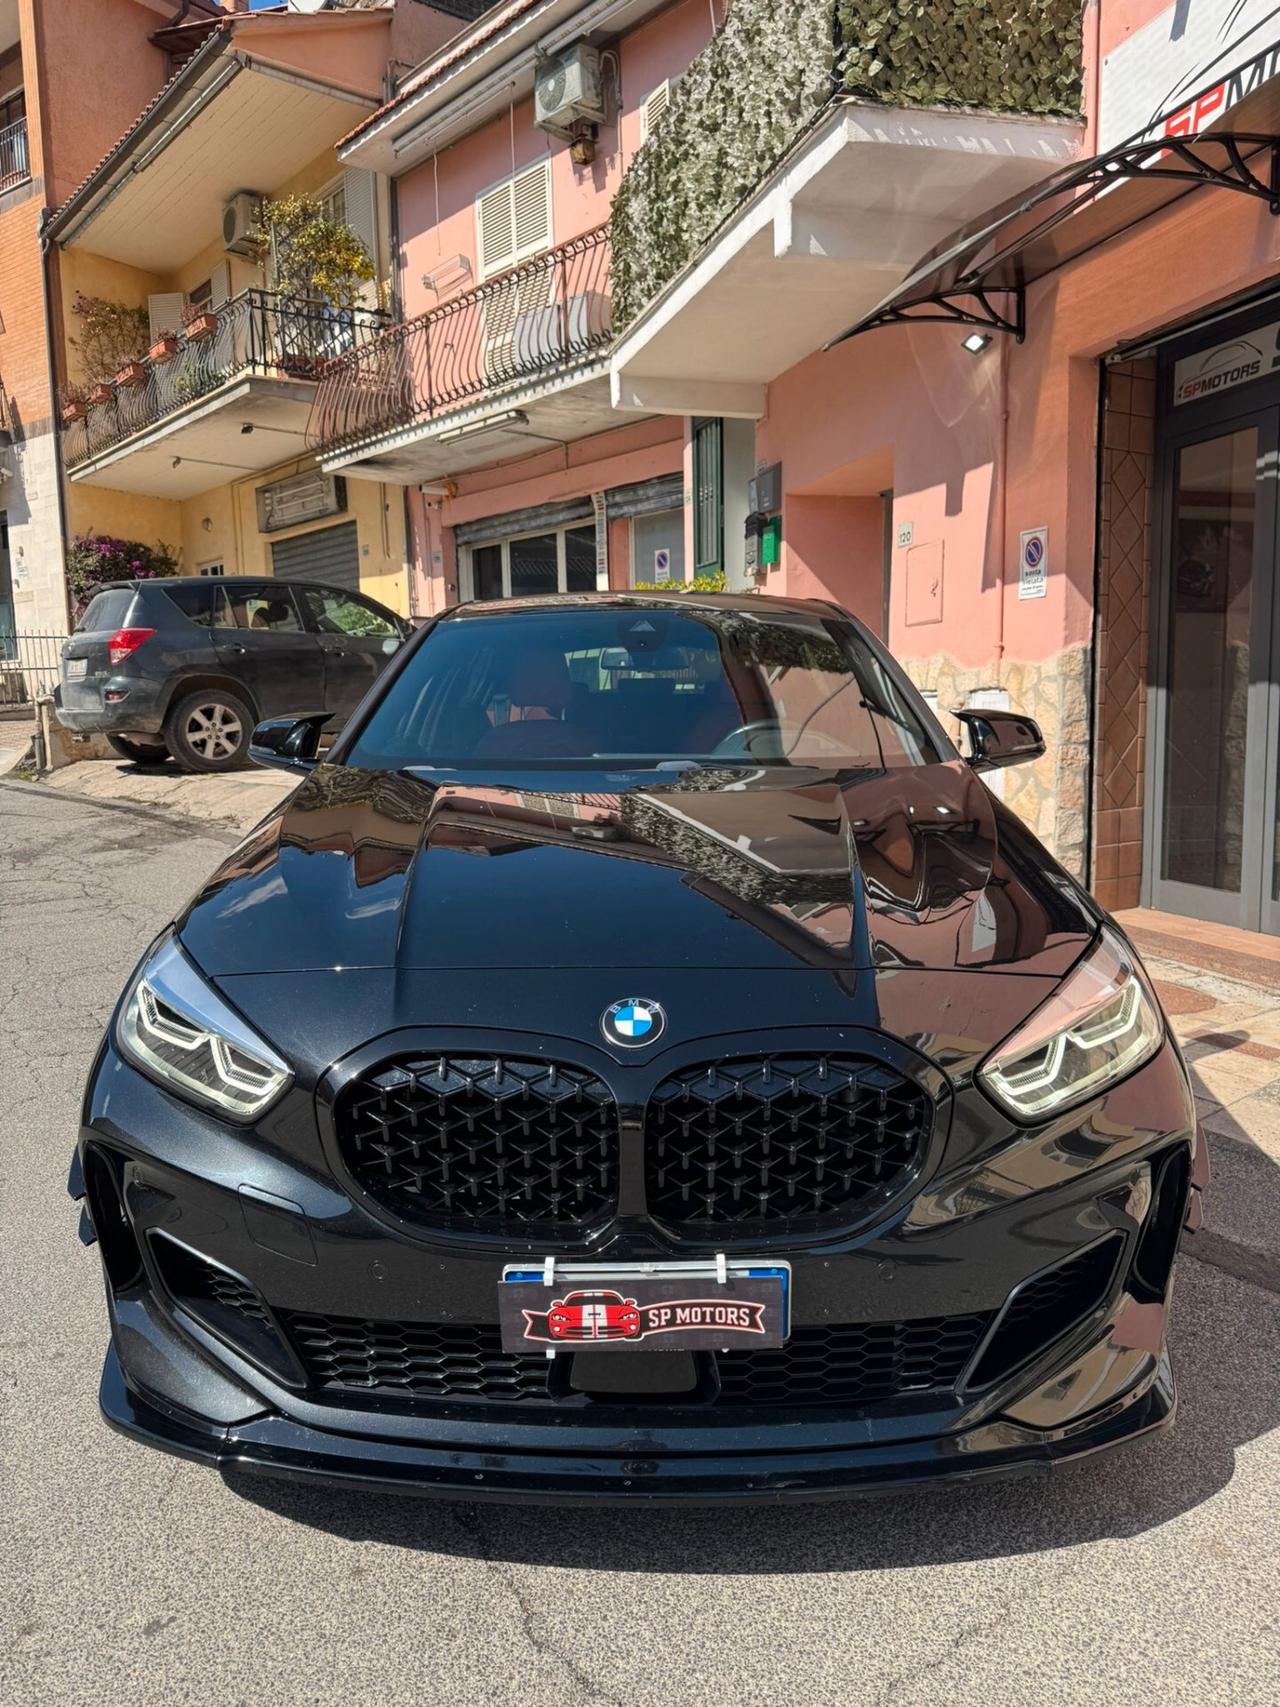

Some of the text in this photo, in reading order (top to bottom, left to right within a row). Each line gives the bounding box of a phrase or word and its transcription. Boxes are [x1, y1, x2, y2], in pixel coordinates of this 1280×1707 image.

[1161, 48, 1280, 158] SPM
[1182, 360, 1261, 399] SPMOTORS
[608, 999, 660, 1014] BMW
[648, 1306, 750, 1328] SP MOTORS
